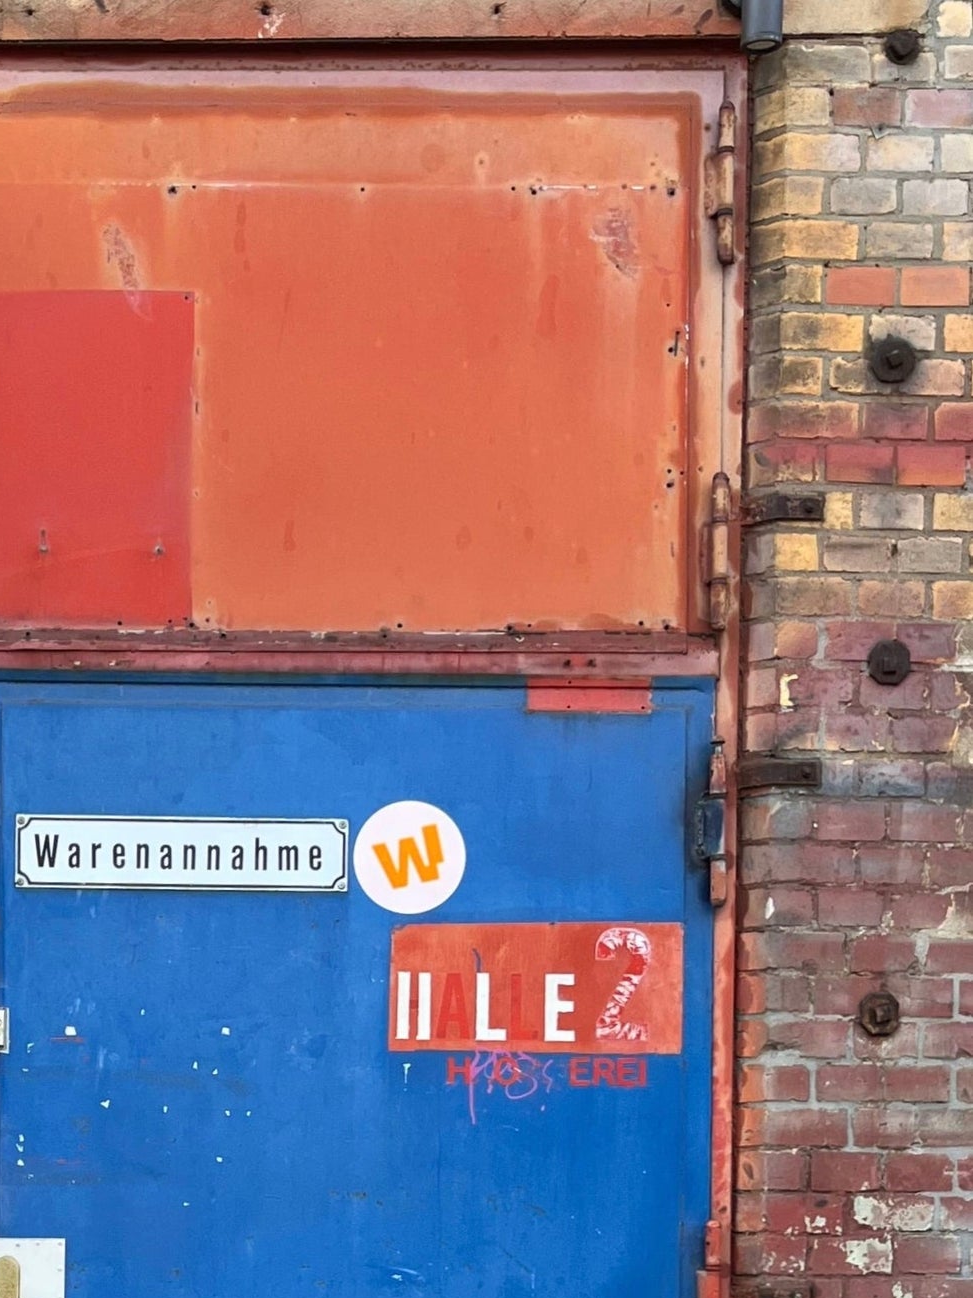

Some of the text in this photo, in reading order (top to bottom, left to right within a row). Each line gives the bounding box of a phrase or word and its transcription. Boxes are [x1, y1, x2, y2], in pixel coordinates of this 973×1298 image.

[33, 833, 324, 871] Warenannahme
[372, 824, 444, 890] W
[395, 927, 652, 1042] HALLE 2
